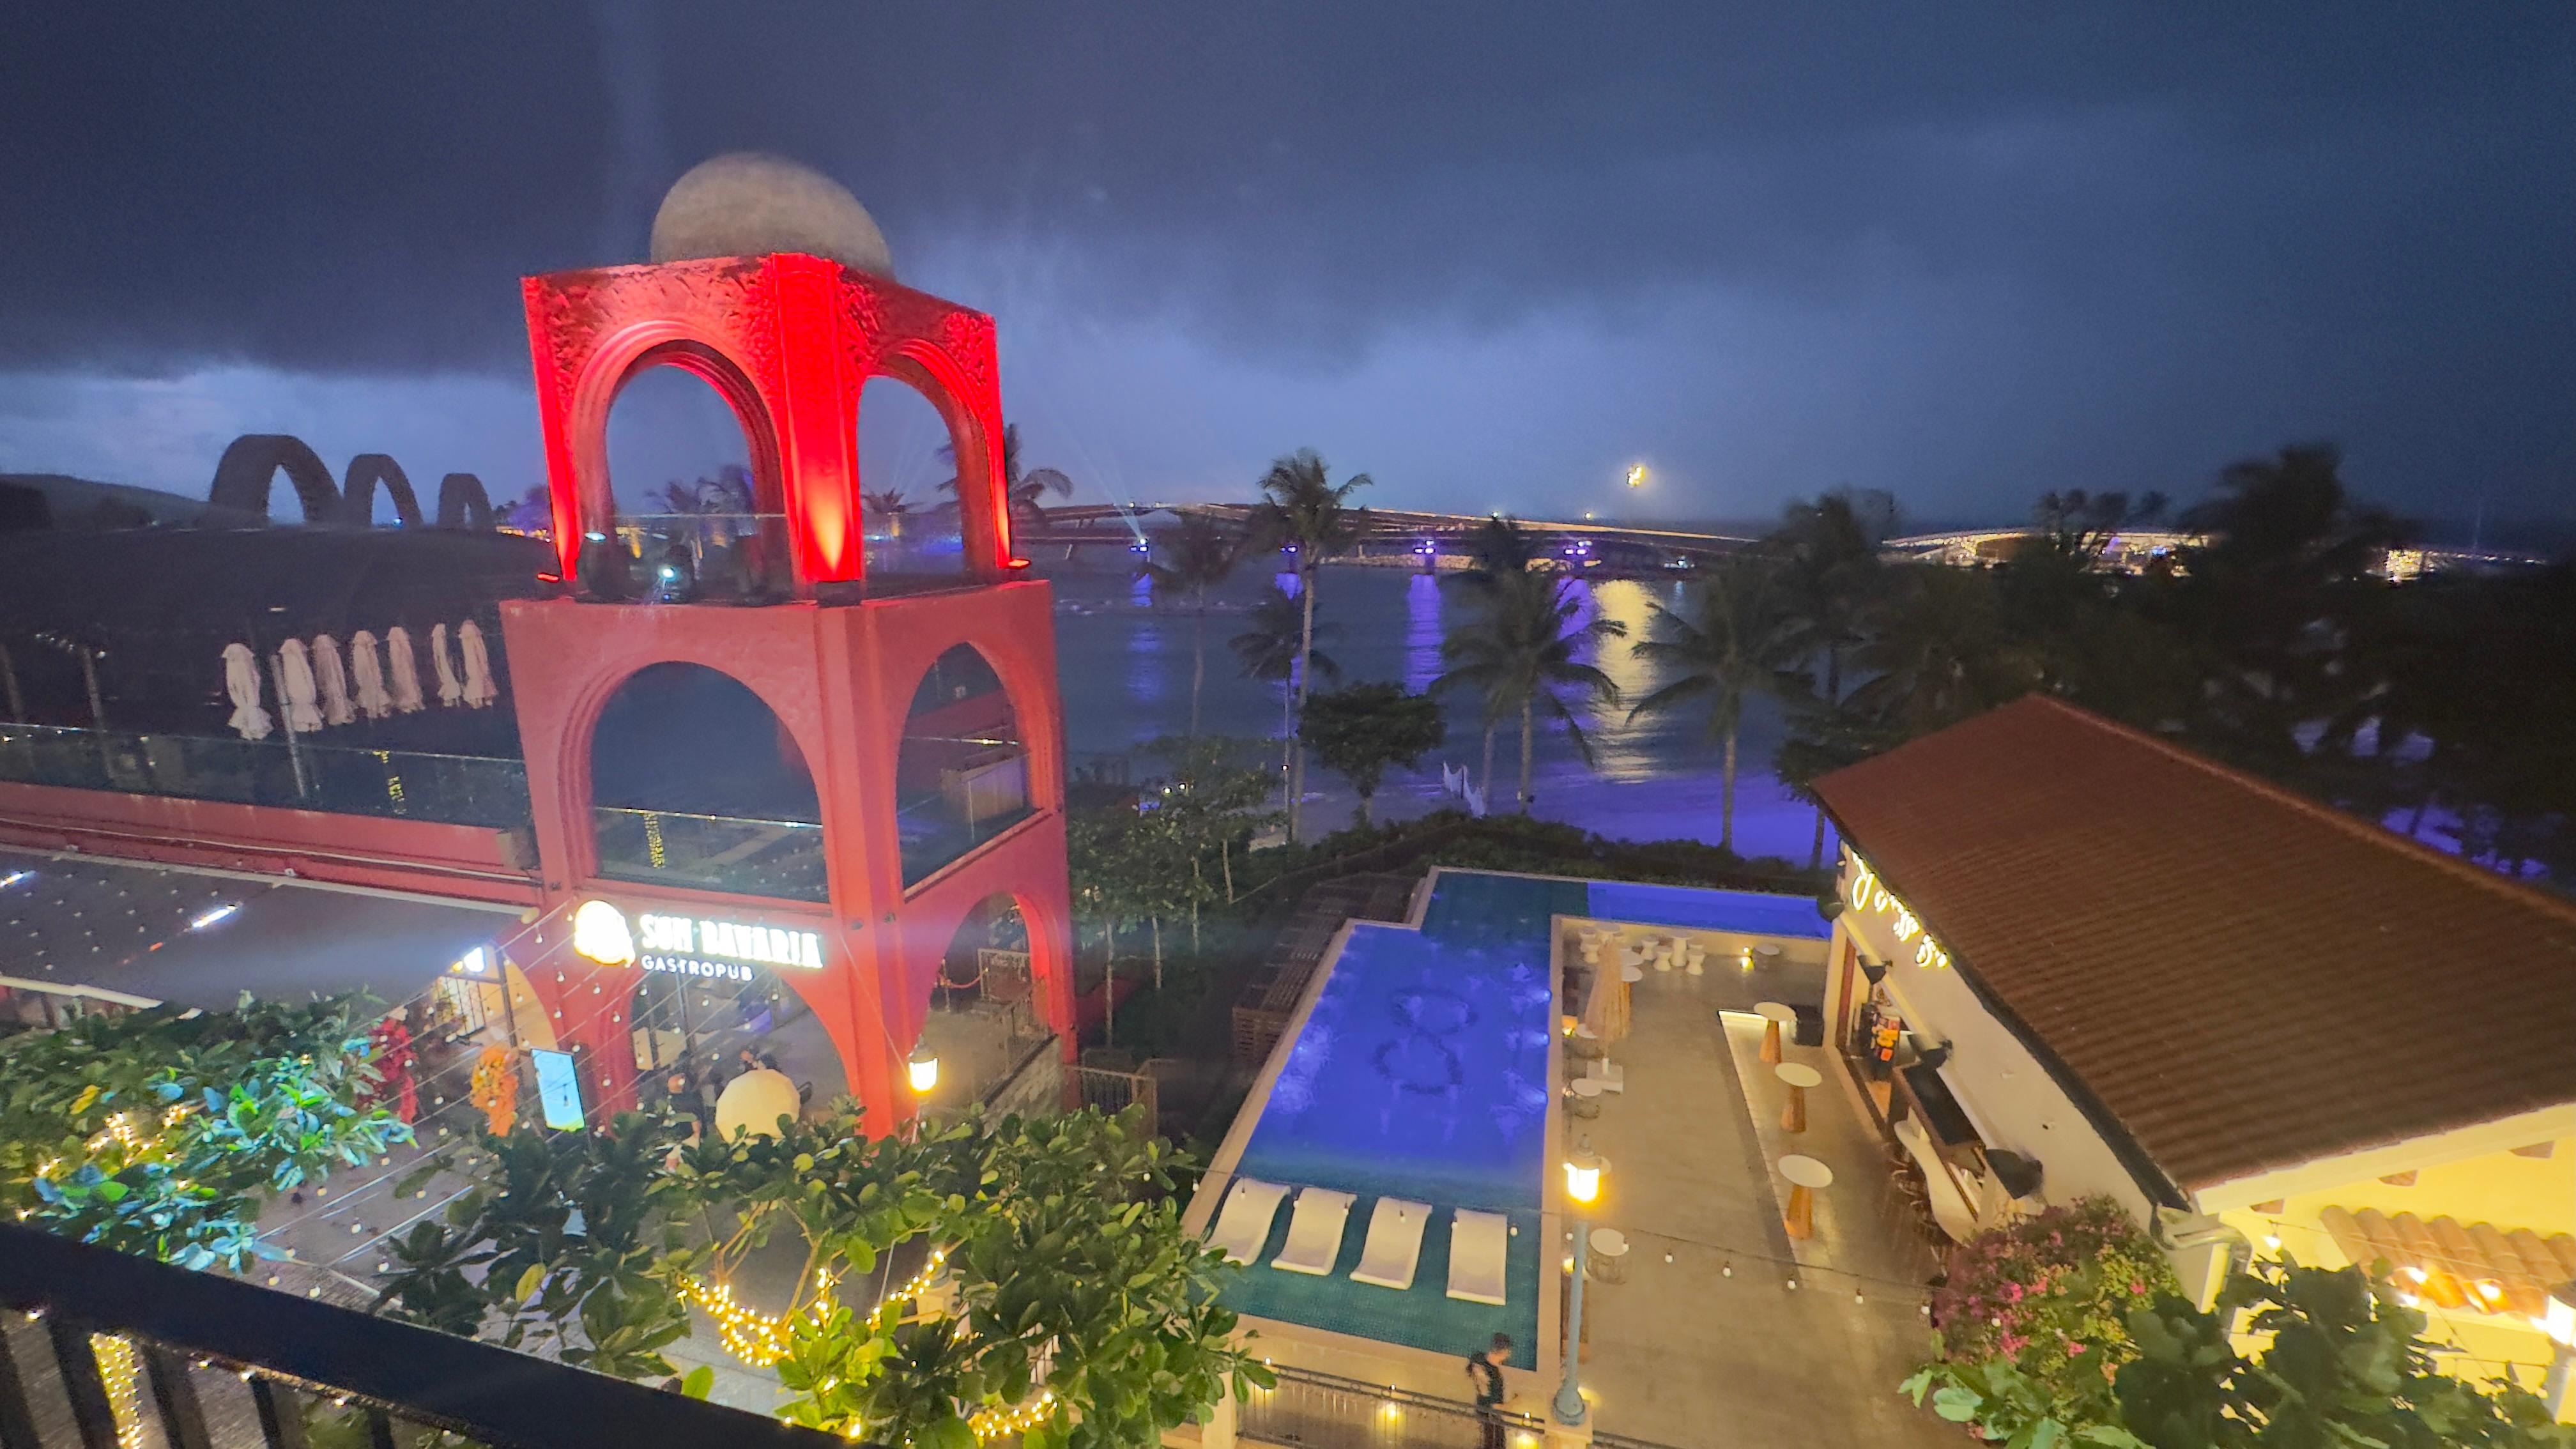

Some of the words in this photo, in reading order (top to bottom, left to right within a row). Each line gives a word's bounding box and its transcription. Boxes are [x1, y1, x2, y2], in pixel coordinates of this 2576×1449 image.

[640, 914, 694, 953] SUN
[700, 920, 824, 969] BAVARIA
[641, 954, 754, 981] GASTROPUB
